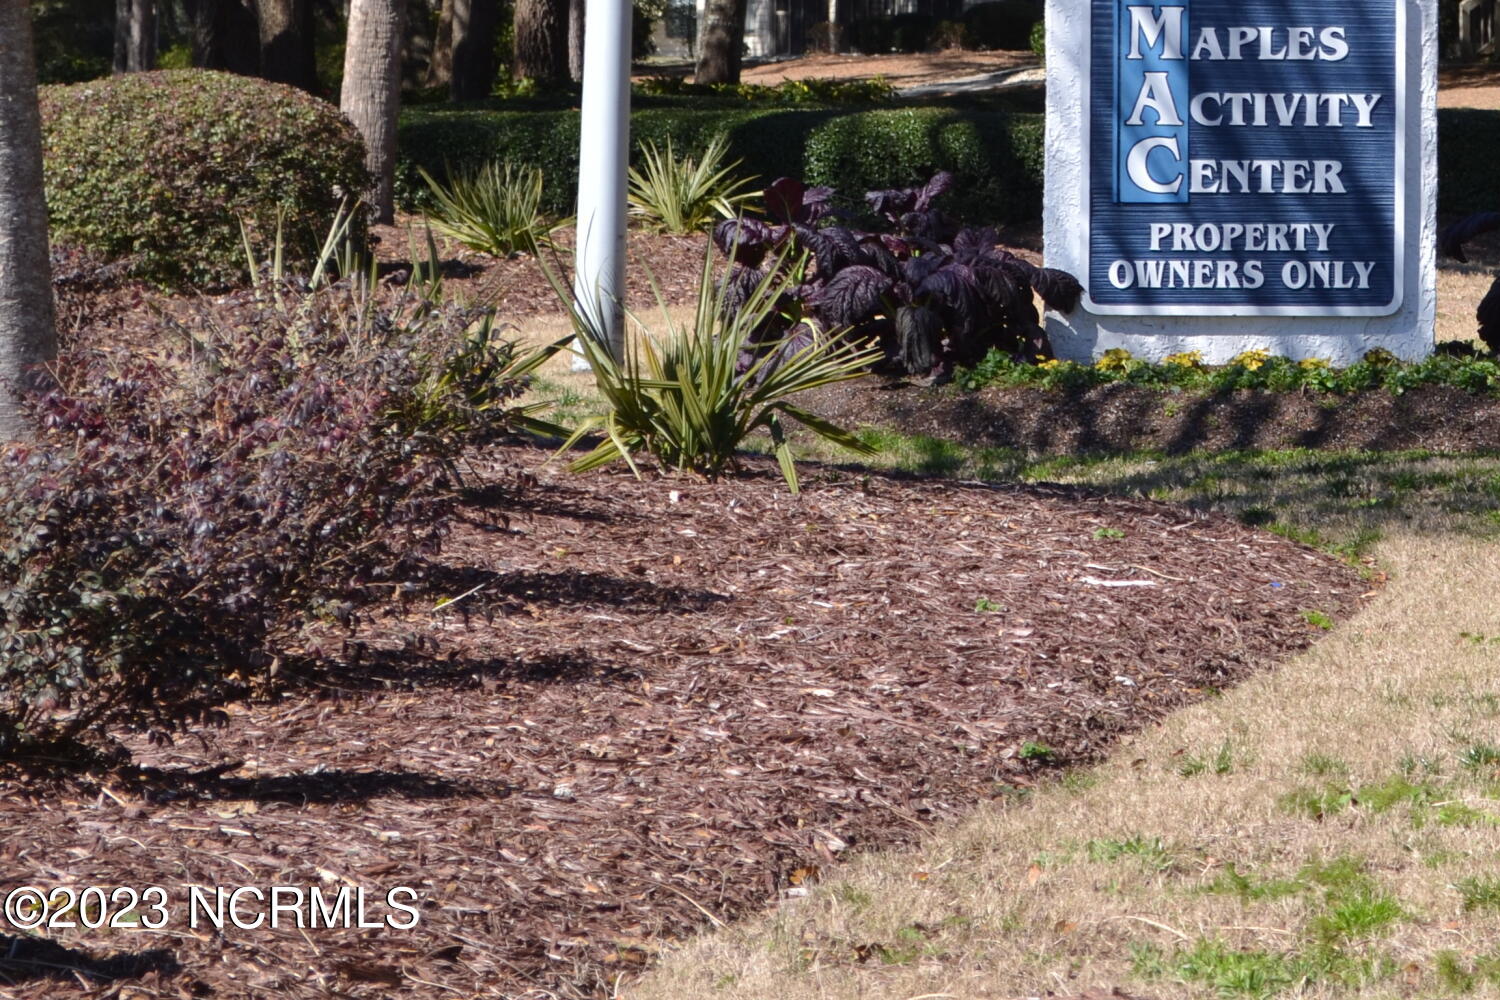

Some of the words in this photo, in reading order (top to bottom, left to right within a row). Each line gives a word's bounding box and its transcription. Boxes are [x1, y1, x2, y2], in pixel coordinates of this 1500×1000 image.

[1126, 5, 1350, 62] MAPLES
[1125, 70, 1382, 128] ACTIVITY
[1126, 136, 1347, 195] CENTER
[1149, 222, 1336, 252] PROPERTY
[1107, 260, 1265, 290] OWNERS
[1281, 260, 1376, 290] ONLY
